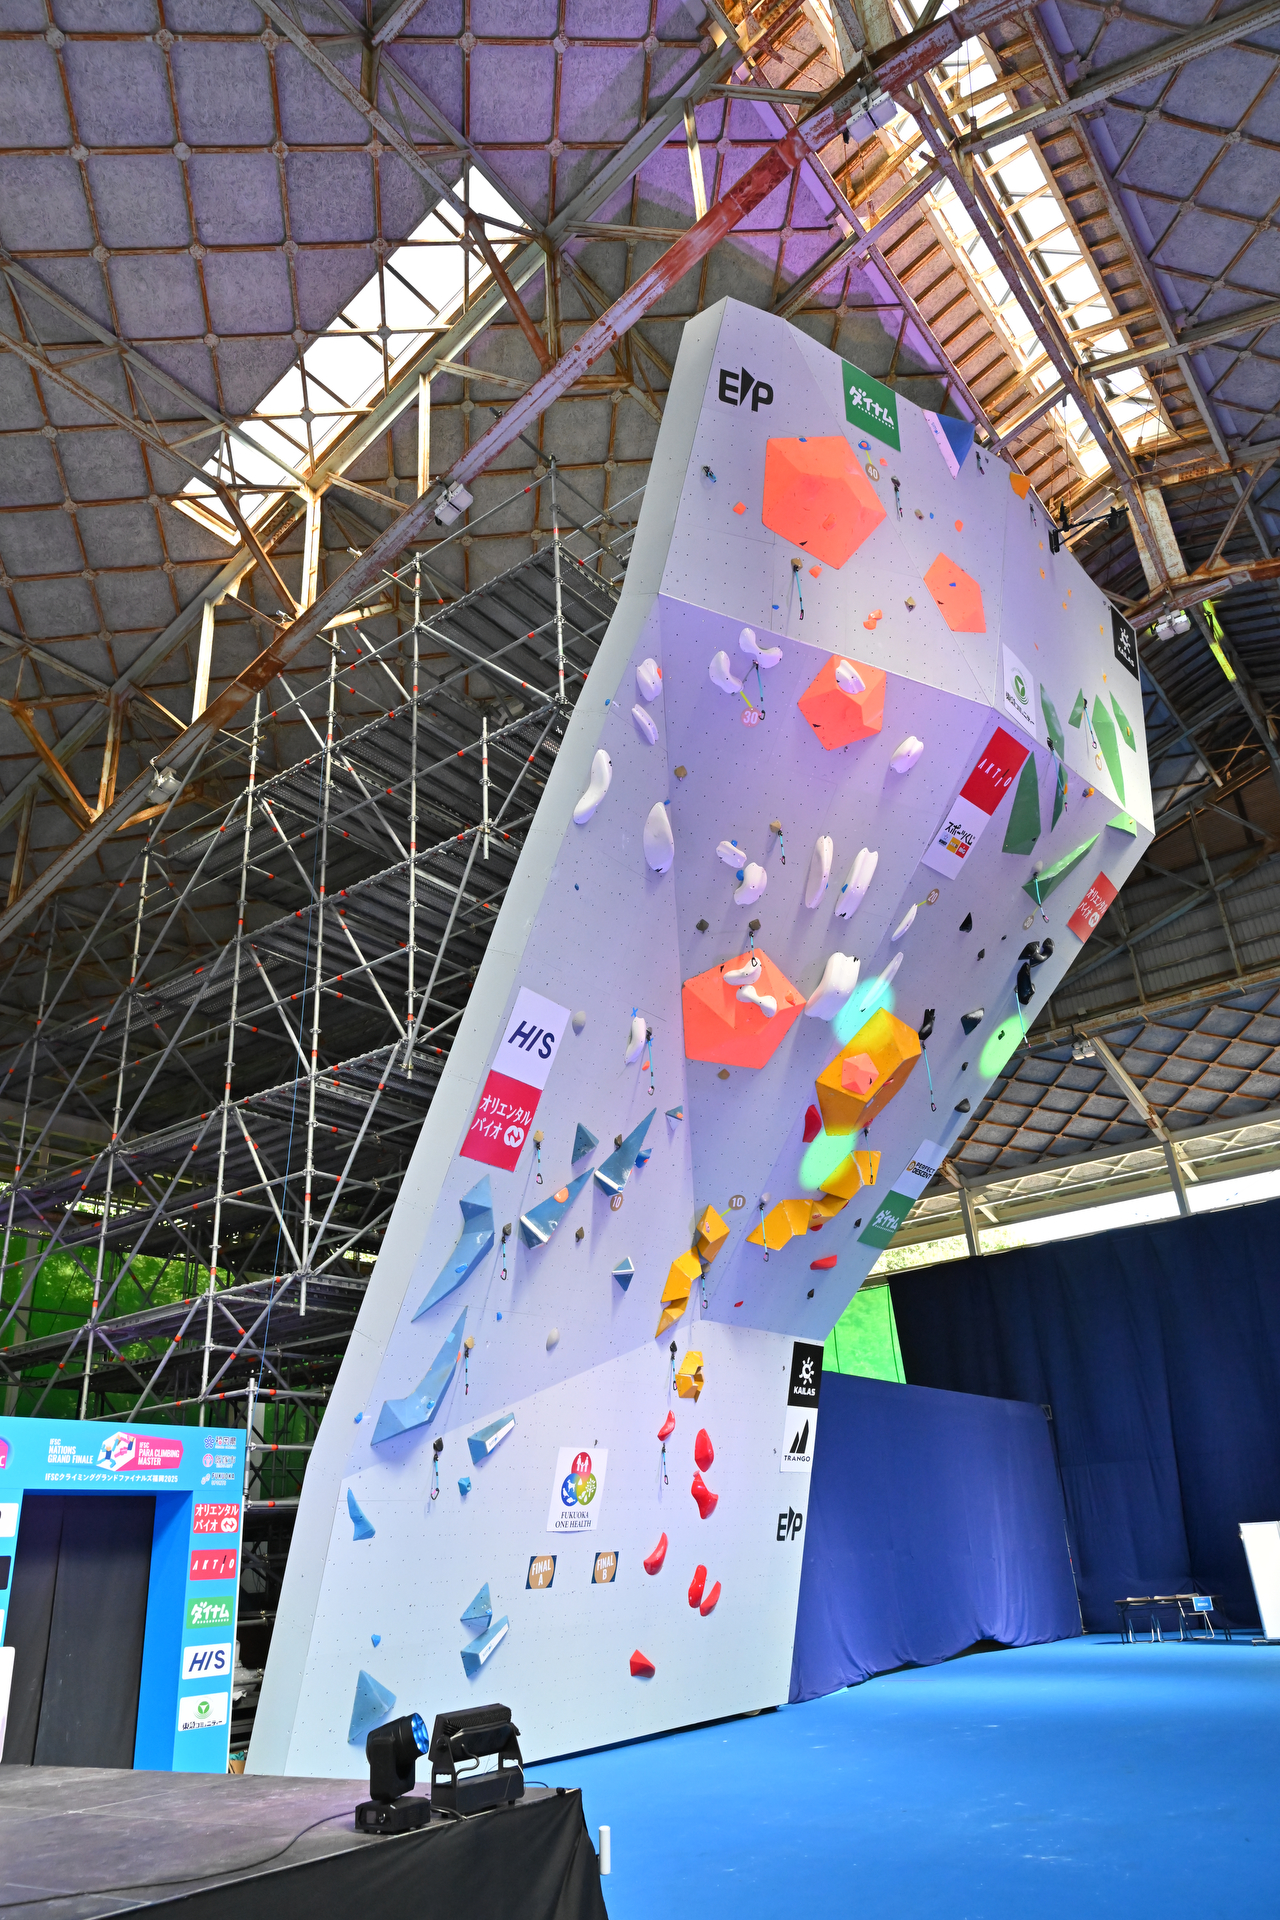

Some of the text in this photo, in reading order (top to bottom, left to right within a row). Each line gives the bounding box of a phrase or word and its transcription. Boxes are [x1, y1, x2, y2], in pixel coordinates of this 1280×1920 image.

[849, 385, 895, 426] ダイナム
[867, 466, 878, 479] 40
[743, 710, 758, 724] 30
[978, 758, 1012, 787] AKTIO
[944, 821, 976, 846] スポーツくじ
[927, 890, 939, 903] 20
[508, 1020, 555, 1059] HIS
[479, 1094, 532, 1126] オリエンタル
[471, 1117, 503, 1140] バイオ
[911, 1167, 932, 1179] DESCENT
[916, 1162, 936, 1174] PERFECT
[612, 1195, 622, 1208] 10
[732, 1197, 743, 1207] 10
[872, 1209, 900, 1230] ダイナム
[793, 1386, 816, 1396] KAILAS
[48, 1445, 76, 1455] NATIONS
[138, 1449, 180, 1458] PARA CLIMBING
[47, 1454, 94, 1464] GRAND FINALE
[138, 1457, 162, 1466] MASTER
[194, 1504, 239, 1517] オリエンタル
[560, 1511, 589, 1519] FUKUOKA
[193, 1519, 218, 1532] バイオ
[569, 1520, 592, 1528] HEALTH
[192, 1555, 235, 1574] AKTIO
[531, 1559, 551, 1576] FINAL
[596, 1555, 614, 1571] FINAL
[538, 1574, 543, 1586] A
[602, 1569, 607, 1581] B
[191, 1601, 229, 1624] ダイナム
[188, 1650, 225, 1672] HIS
